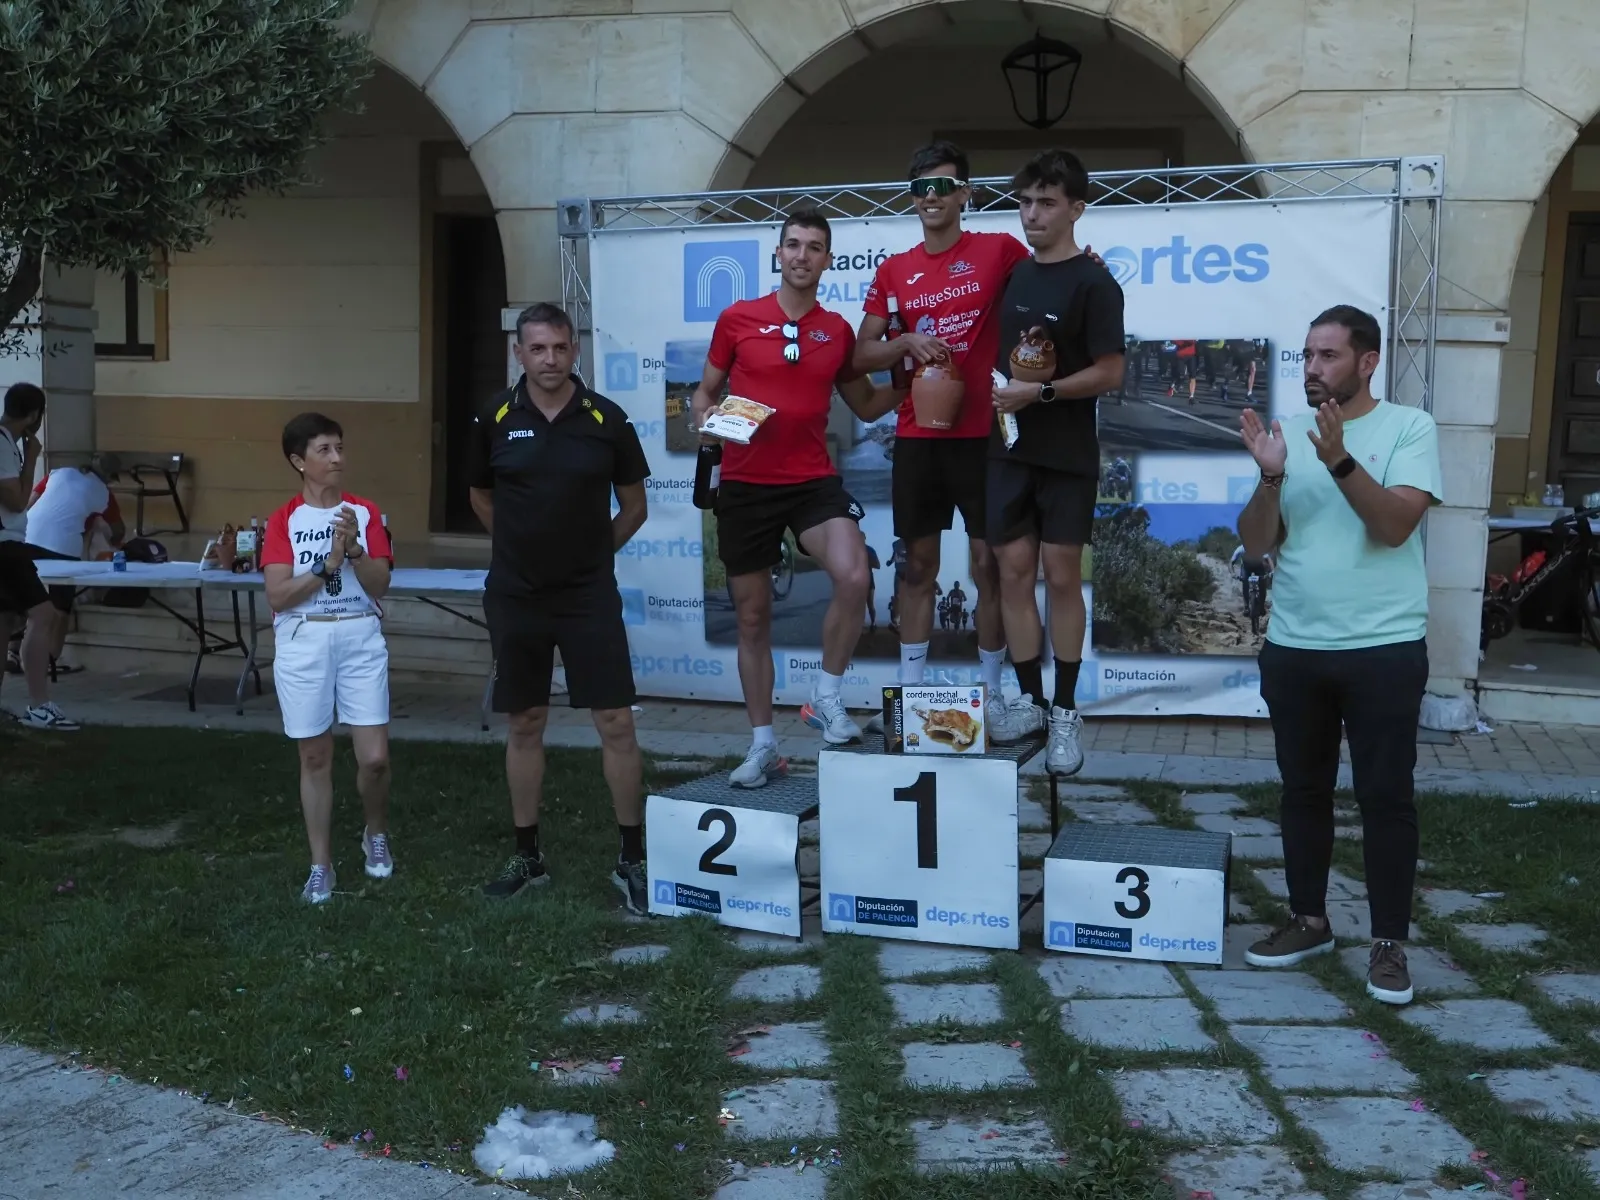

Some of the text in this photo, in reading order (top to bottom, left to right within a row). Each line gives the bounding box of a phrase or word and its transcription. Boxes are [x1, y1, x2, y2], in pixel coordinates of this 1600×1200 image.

[1101, 235, 1270, 286] ortes
[905, 281, 981, 310] #eligeSoria
[938, 309, 980, 326] Soria puro
[645, 478, 695, 490] Diputació
[631, 653, 724, 677] eportes
[1104, 668, 1176, 682] Diputación
[905, 690, 958, 699] cordero lechal
[929, 698, 968, 706] cascajares
[894, 698, 902, 735] cascajares
[893, 771, 938, 869] 1
[697, 808, 738, 877] 2
[677, 886, 710, 901] Diputación
[1114, 866, 1151, 919] 3
[677, 895, 720, 910] DE PALENCIA
[727, 896, 792, 917] deportes
[858, 901, 905, 913] Diputación
[858, 911, 916, 924] DE PALENCIA
[925, 906, 1010, 929] deportes
[1077, 927, 1120, 940] Diputación
[1139, 932, 1217, 952] deportes
[1077, 937, 1130, 949] DE PALENCIA
